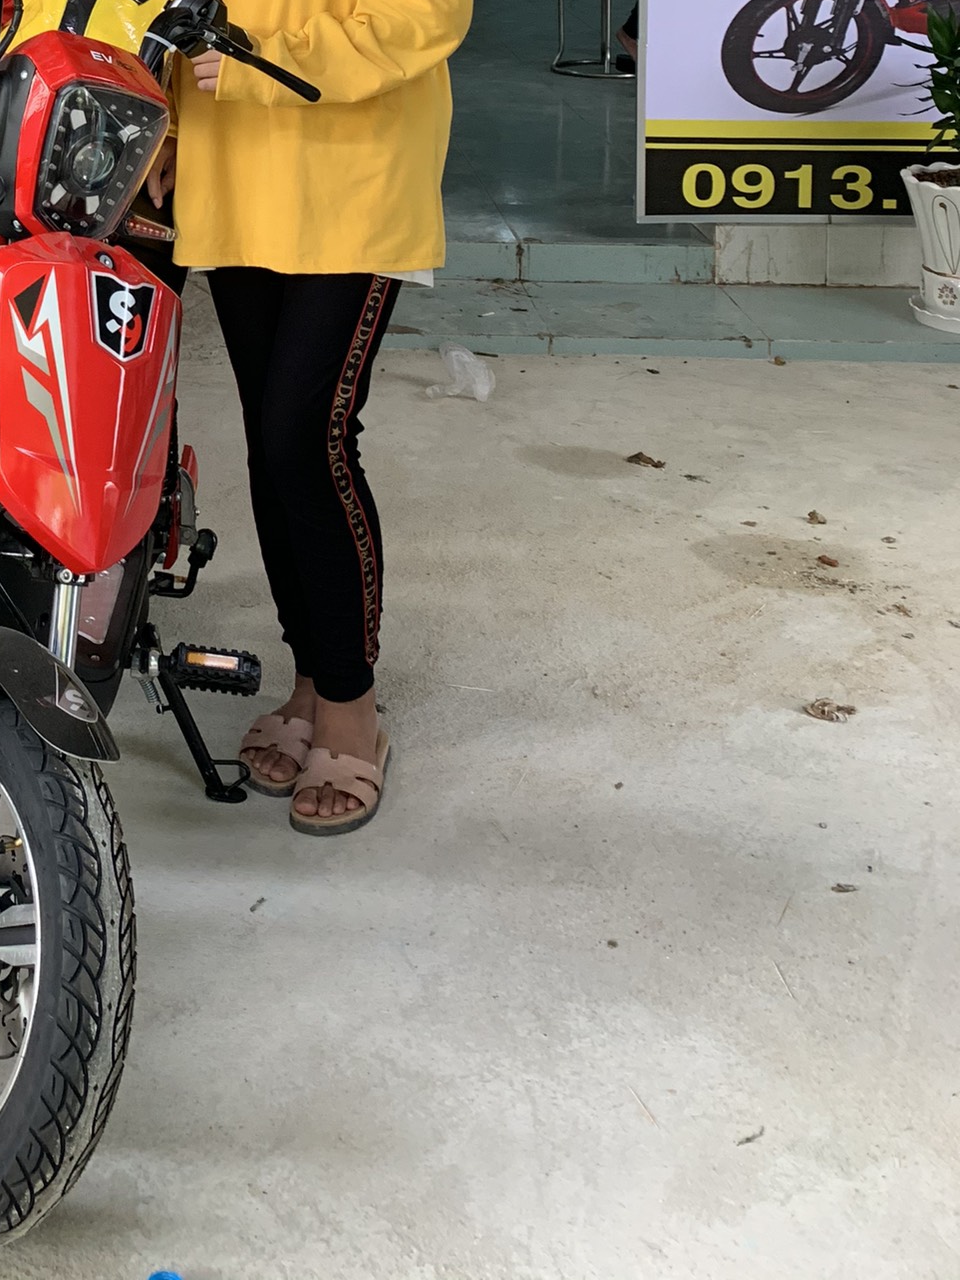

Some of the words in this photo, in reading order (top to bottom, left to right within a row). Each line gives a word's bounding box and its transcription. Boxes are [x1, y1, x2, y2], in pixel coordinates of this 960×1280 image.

[90, 50, 113, 64] EV
[349, 324, 372, 364] D&G
[332, 382, 354, 421] D&G
[328, 441, 346, 477] D&G
